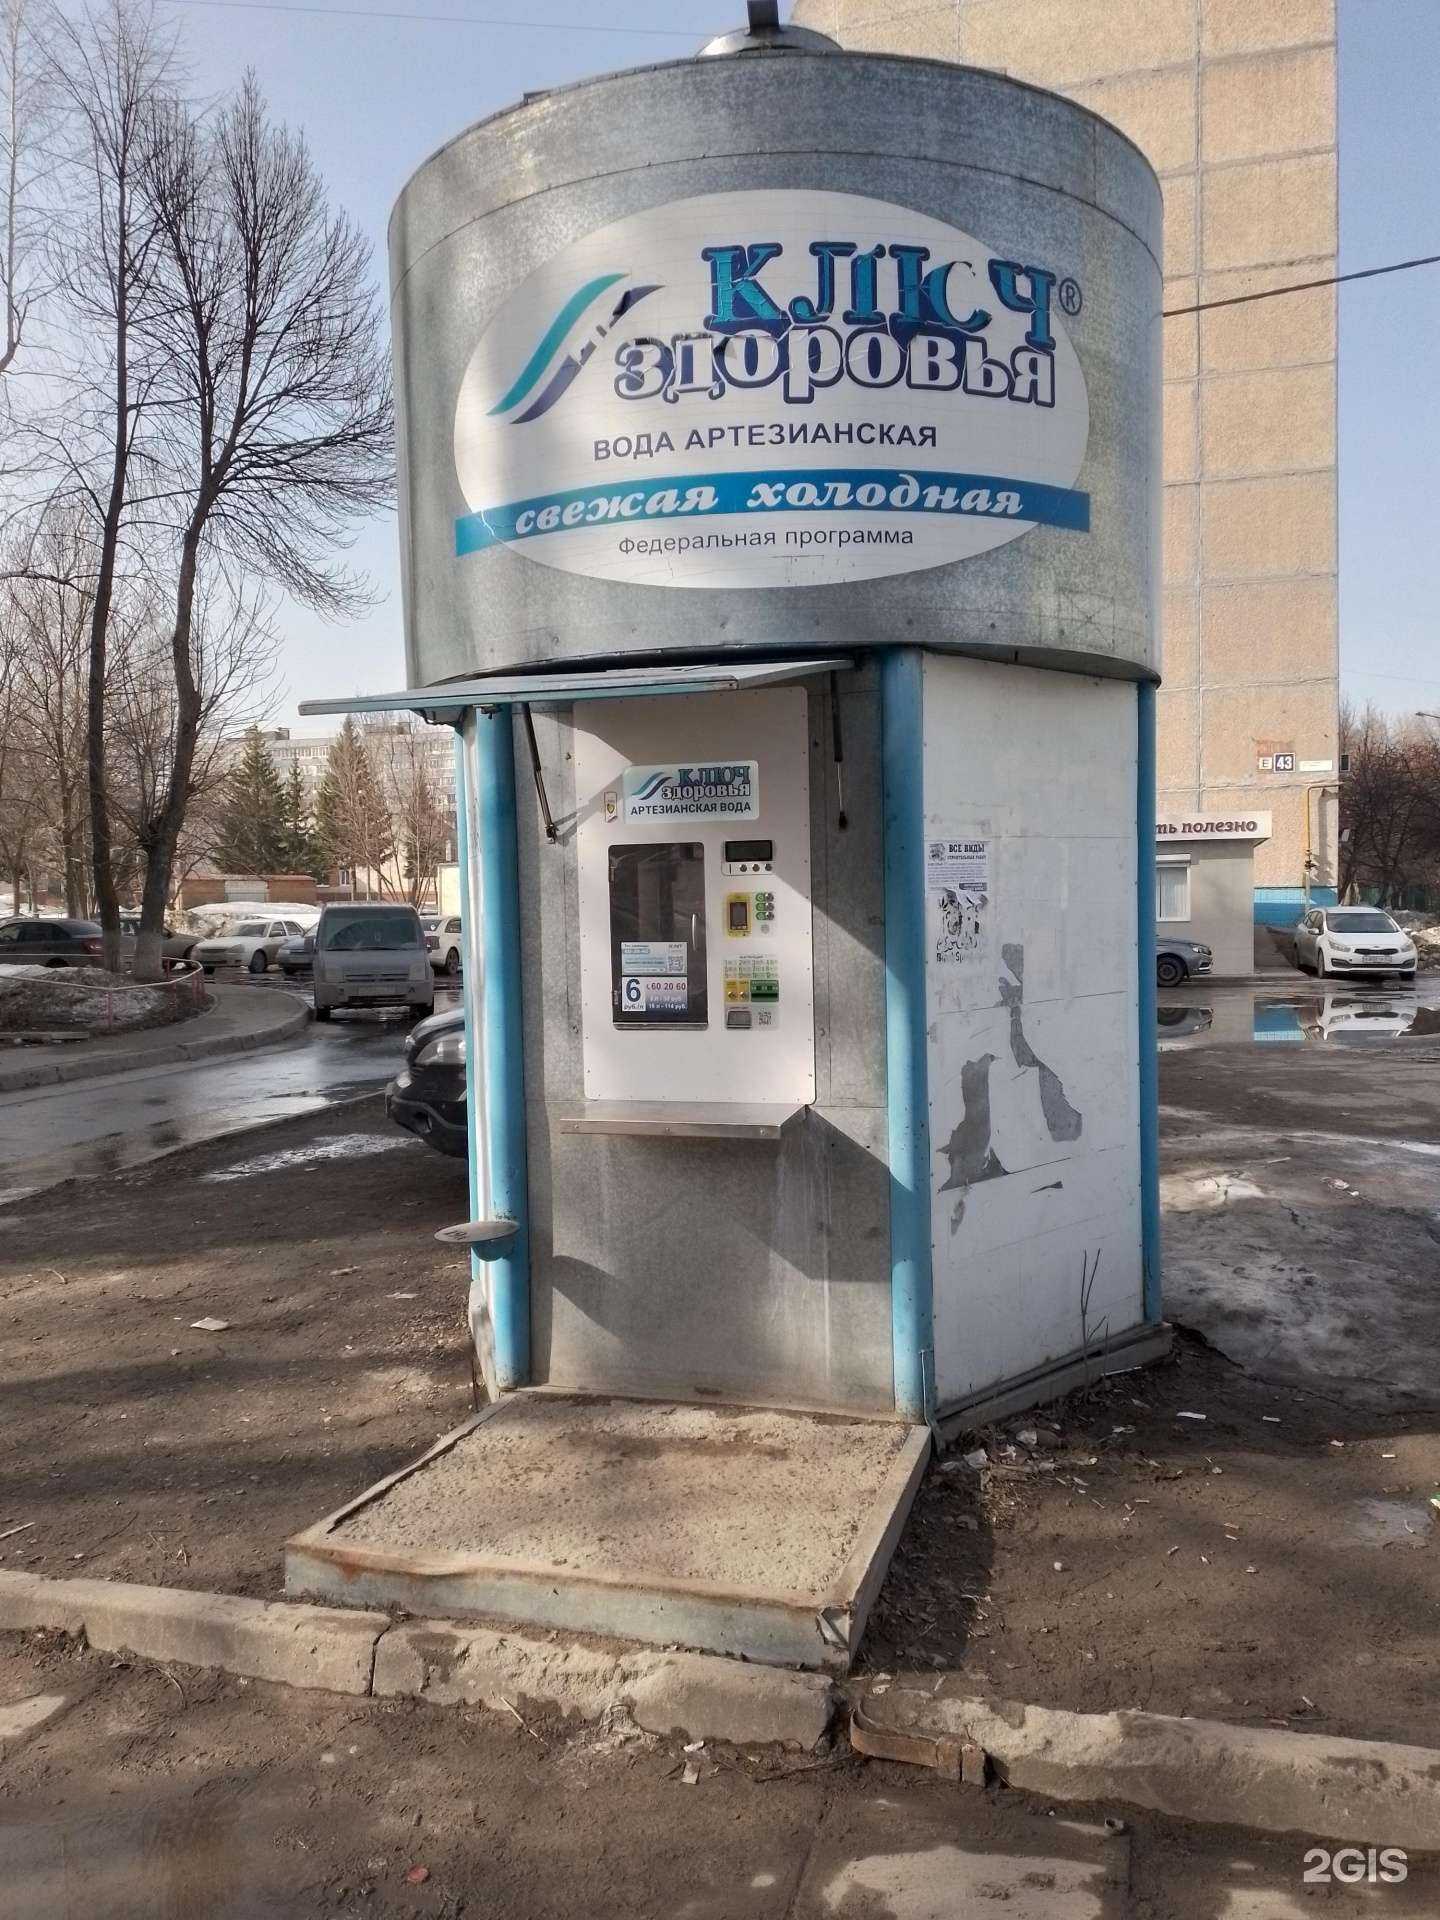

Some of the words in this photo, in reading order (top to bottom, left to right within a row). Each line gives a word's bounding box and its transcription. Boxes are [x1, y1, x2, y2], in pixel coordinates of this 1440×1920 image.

[593, 433, 674, 461] ВОДА
[684, 421, 938, 450] АРТЕЗИАНСКАЯ
[513, 486, 718, 536] свежая
[745, 474, 1024, 516] холодная
[618, 531, 776, 555] Федеральная
[784, 526, 914, 549] программа
[1276, 756, 1293, 770] 43
[678, 766, 750, 785] КЛЮЧ
[631, 803, 717, 816] АРТЕЗИАНСКАЯ
[720, 801, 751, 813] ВОДА
[1181, 820, 1258, 833] полезно
[948, 844, 962, 852] ВСЕ
[964, 844, 985, 852] ВИДЫ
[625, 978, 641, 1002] 6
[651, 982, 661, 990] 60
[664, 982, 673, 990] 20
